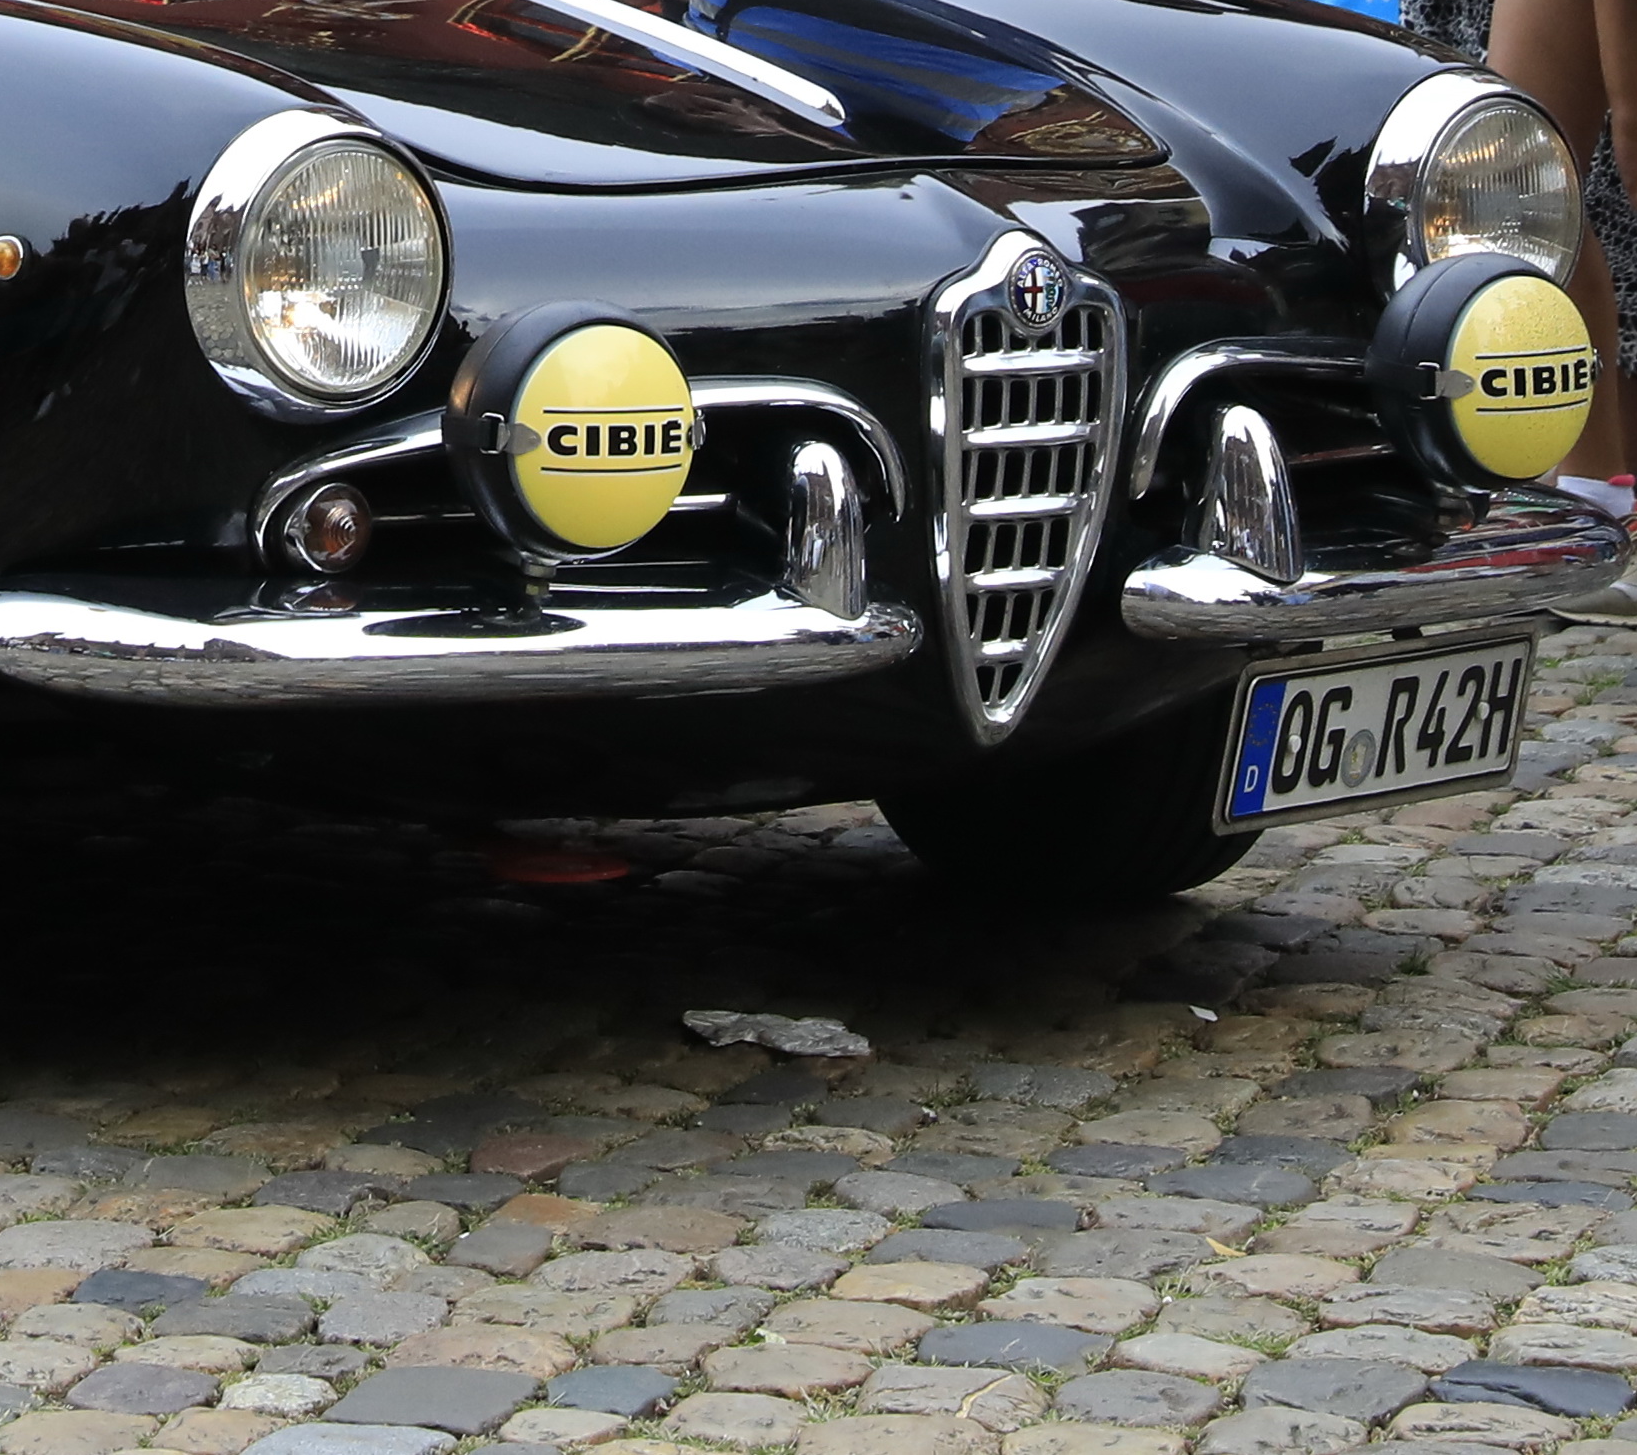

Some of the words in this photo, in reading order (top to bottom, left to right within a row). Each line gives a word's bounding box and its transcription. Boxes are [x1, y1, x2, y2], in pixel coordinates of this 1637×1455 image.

[1023, 306, 1058, 322] MILANO
[1271, 685, 1353, 793] OG
[1244, 765, 1259, 793] D
